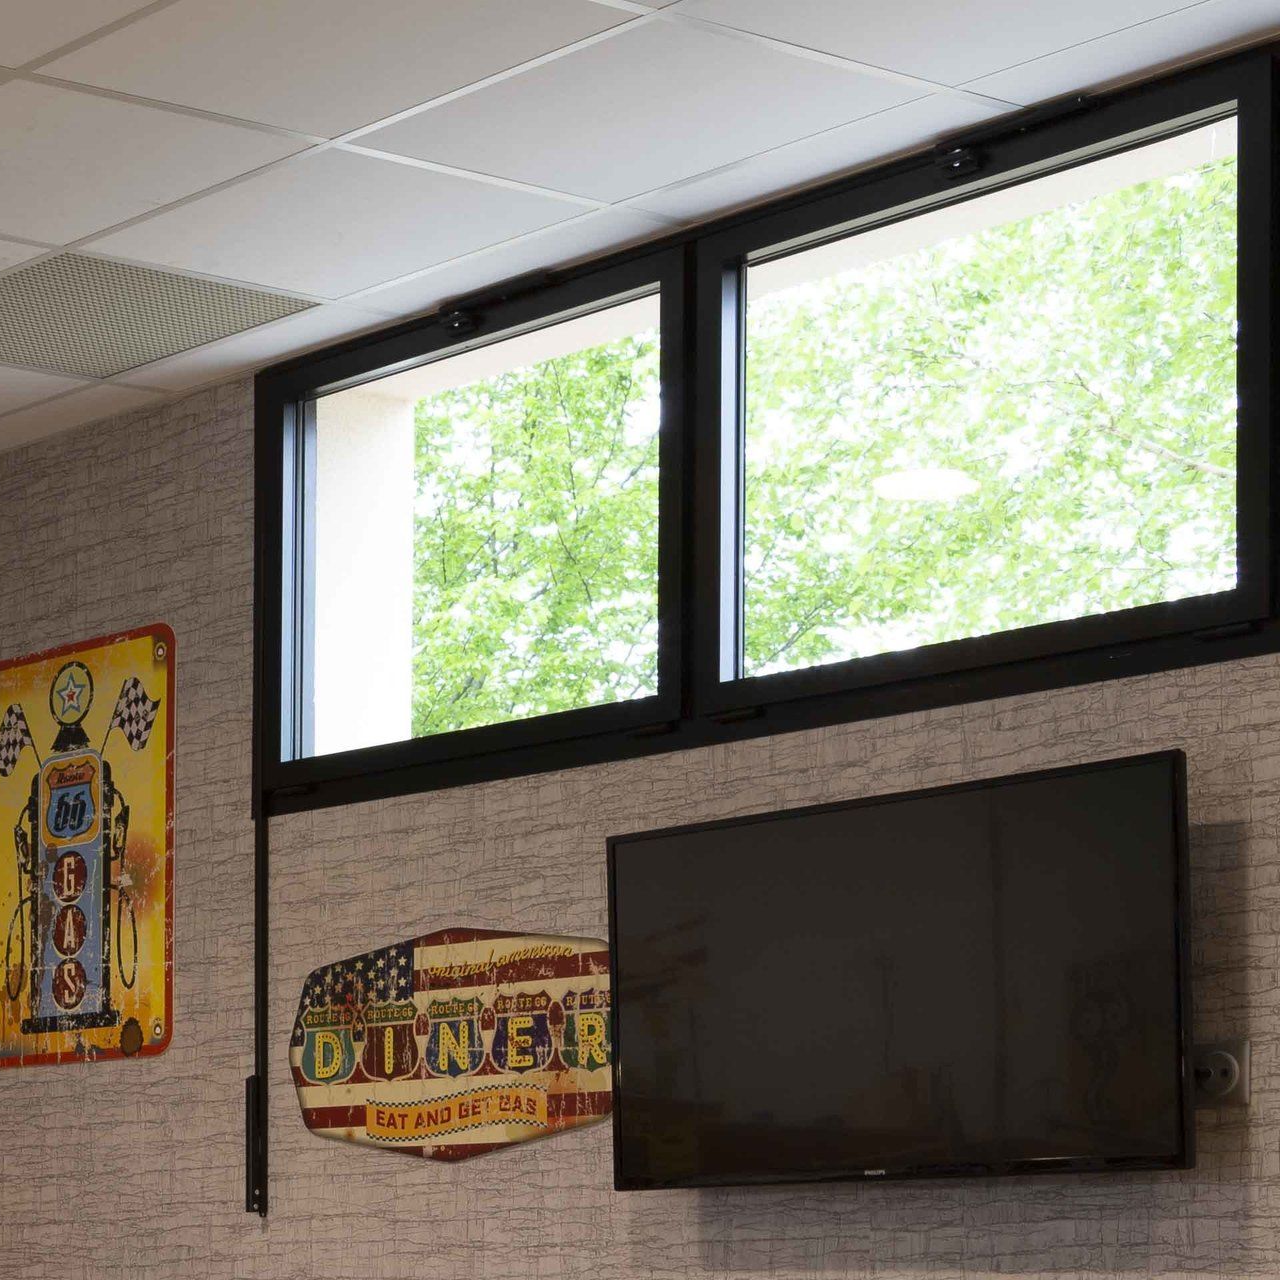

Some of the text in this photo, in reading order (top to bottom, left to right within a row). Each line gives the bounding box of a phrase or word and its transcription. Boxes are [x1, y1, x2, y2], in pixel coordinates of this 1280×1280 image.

[54, 790, 88, 833] 66
[430, 1004, 464, 1016] ROUTE
[497, 996, 547, 1010] ROUTE 66
[306, 1012, 335, 1025] ROUTE
[368, 1007, 413, 1020] ROUTE 66
[314, 1012, 608, 1079] DINER
[375, 1112, 408, 1130] EAT
[414, 1106, 451, 1128] AND
